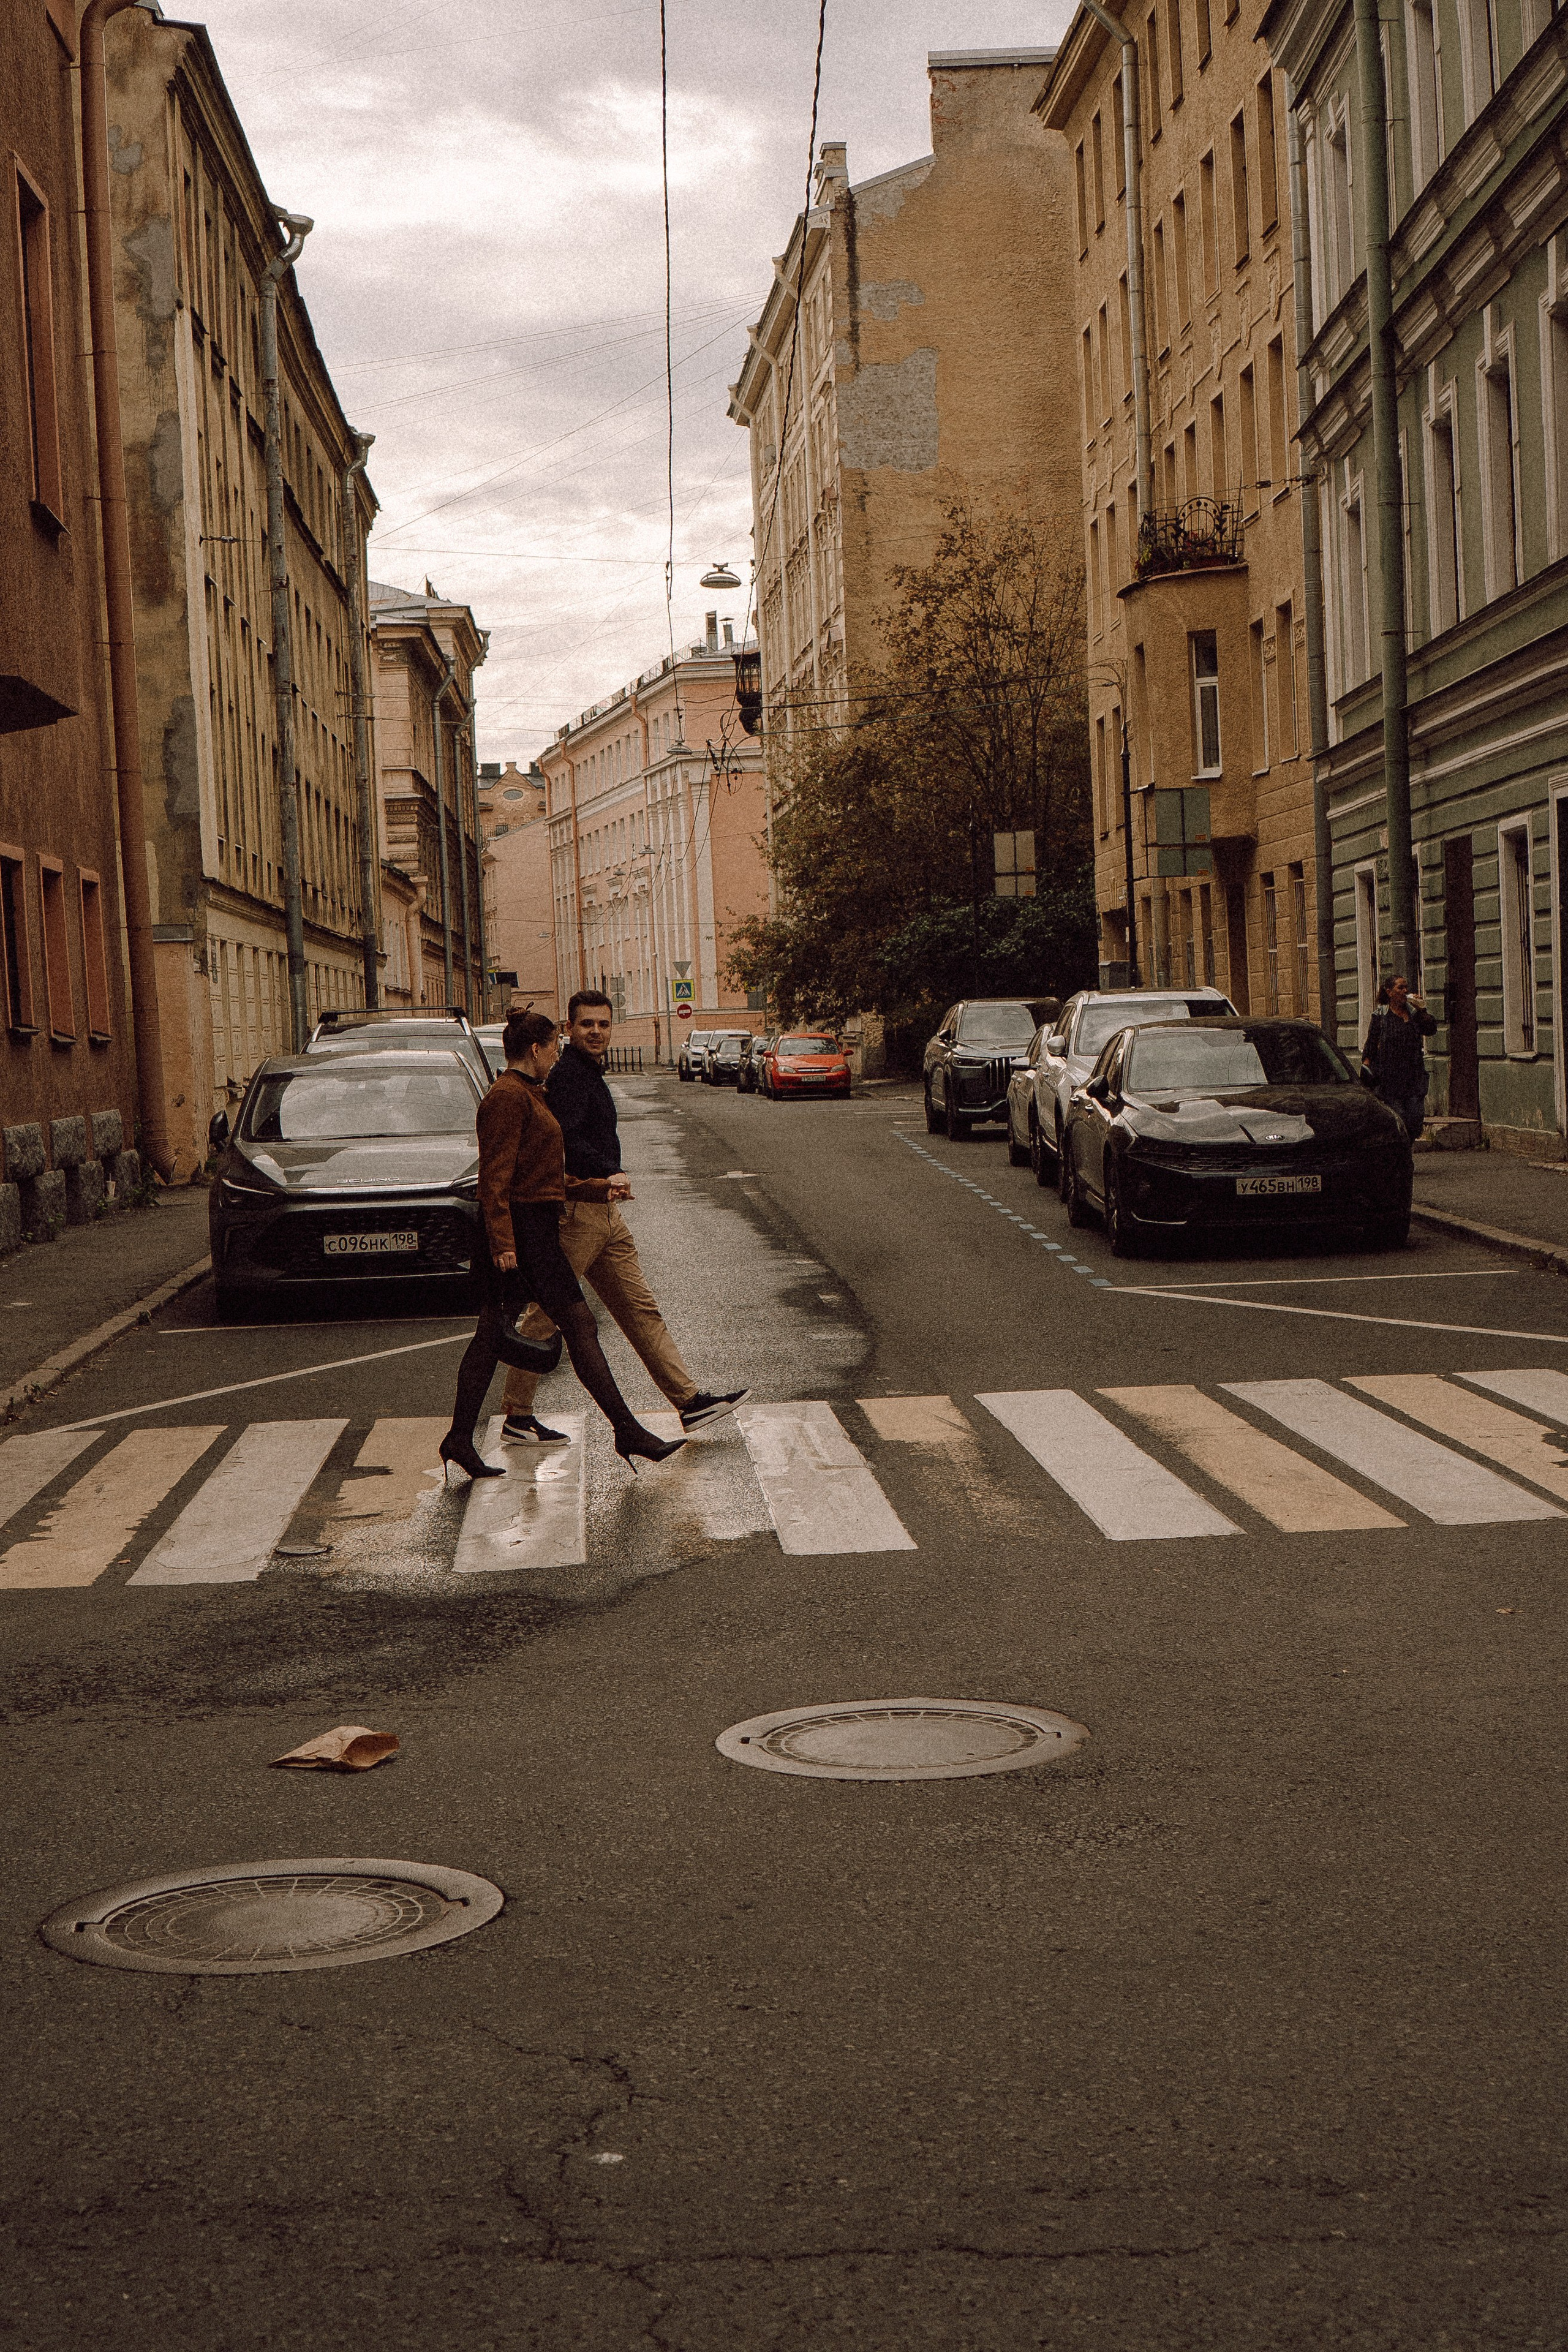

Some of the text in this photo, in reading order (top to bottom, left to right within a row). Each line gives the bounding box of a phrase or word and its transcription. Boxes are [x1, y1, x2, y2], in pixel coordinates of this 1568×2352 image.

[1297, 1177, 1318, 1188] 198
[328, 1233, 414, 1252] С096НК 198
